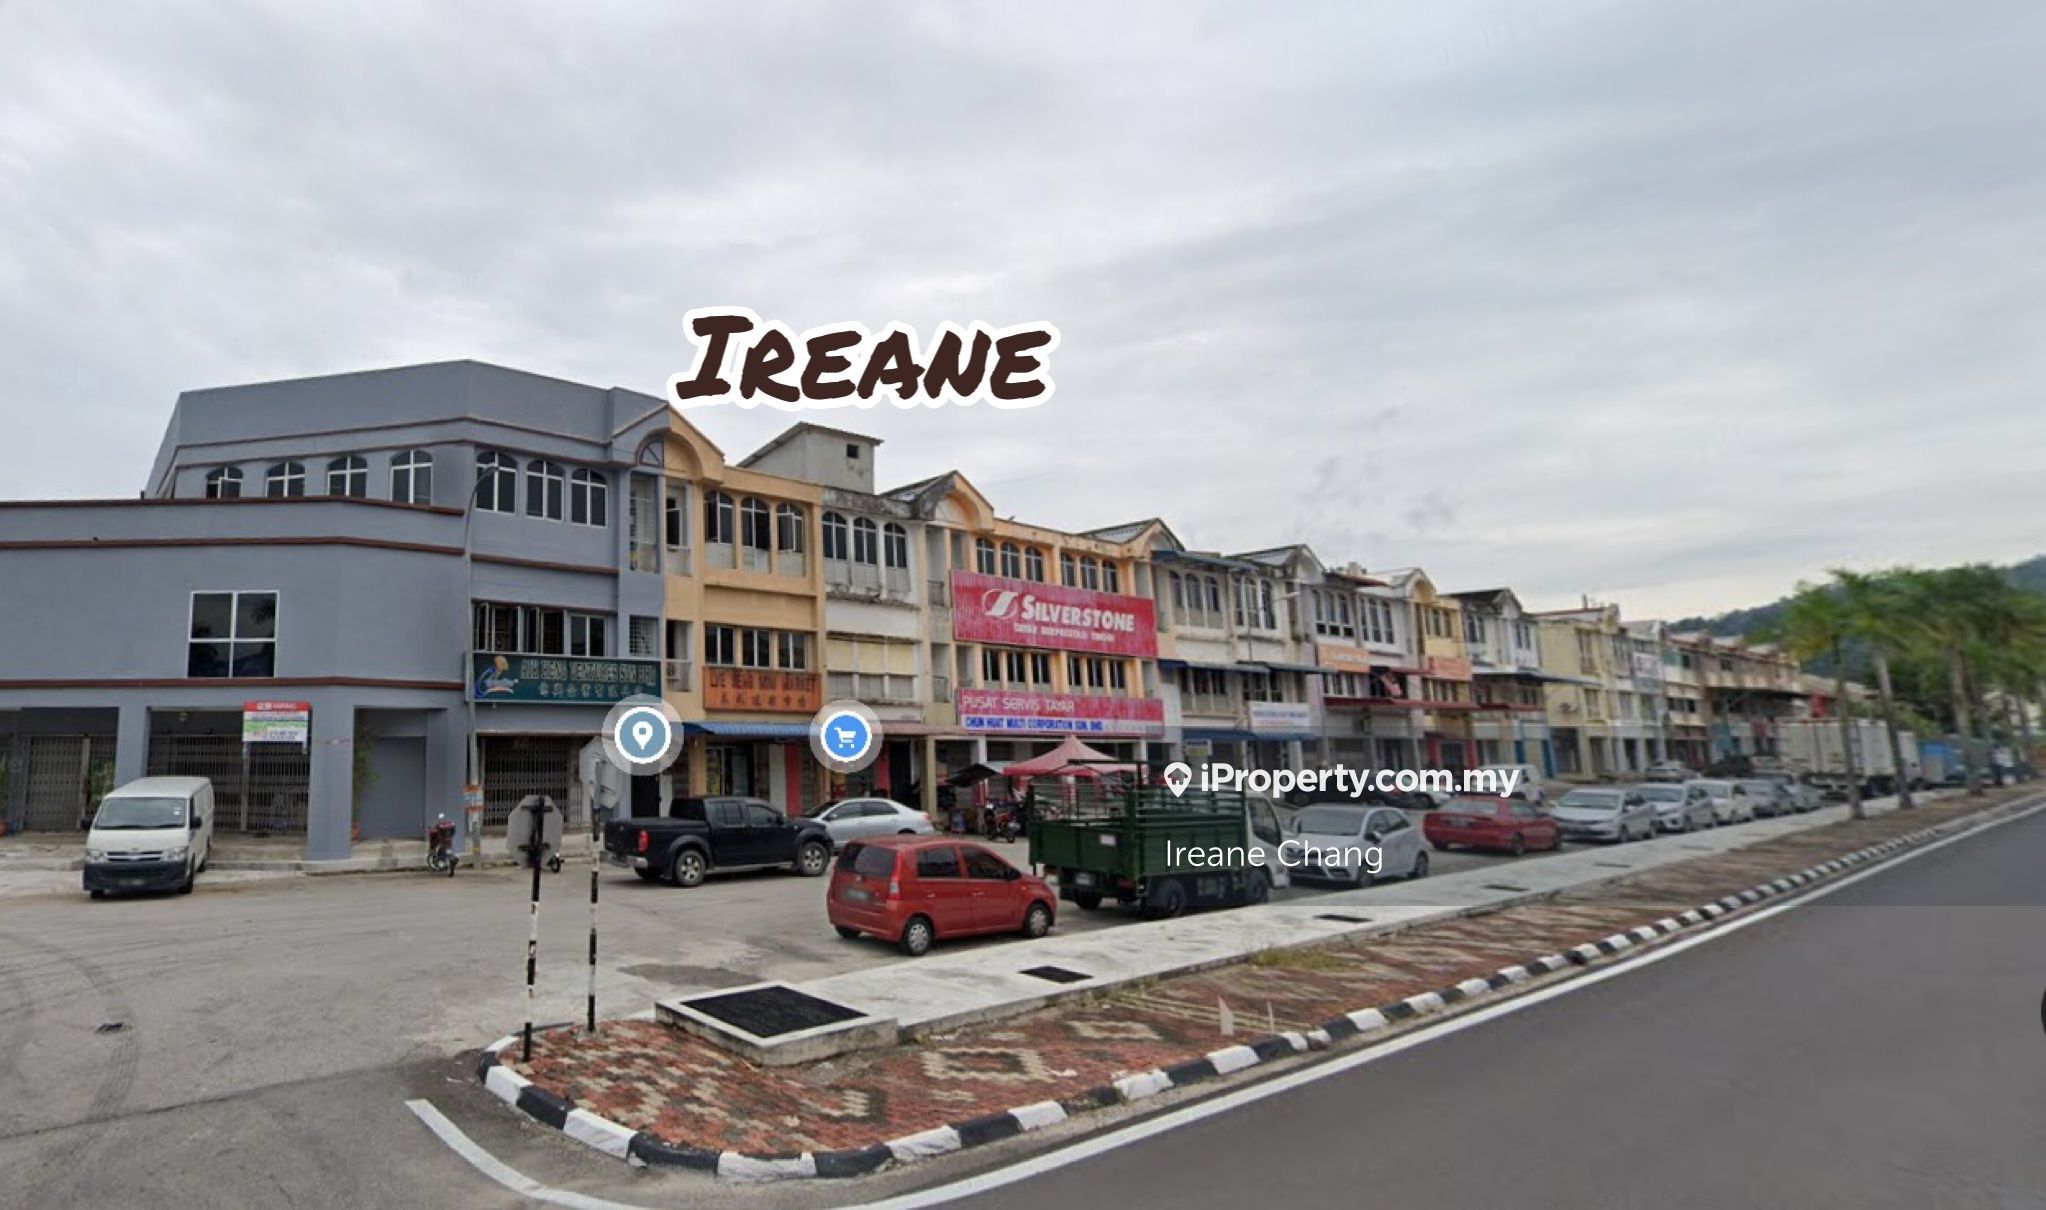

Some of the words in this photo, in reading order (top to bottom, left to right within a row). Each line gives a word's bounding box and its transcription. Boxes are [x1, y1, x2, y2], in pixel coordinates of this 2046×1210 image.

[1020, 594, 1136, 633] SILVERSTONE
[961, 695, 998, 709] PUSAT
[1002, 697, 1041, 711] SERVIS
